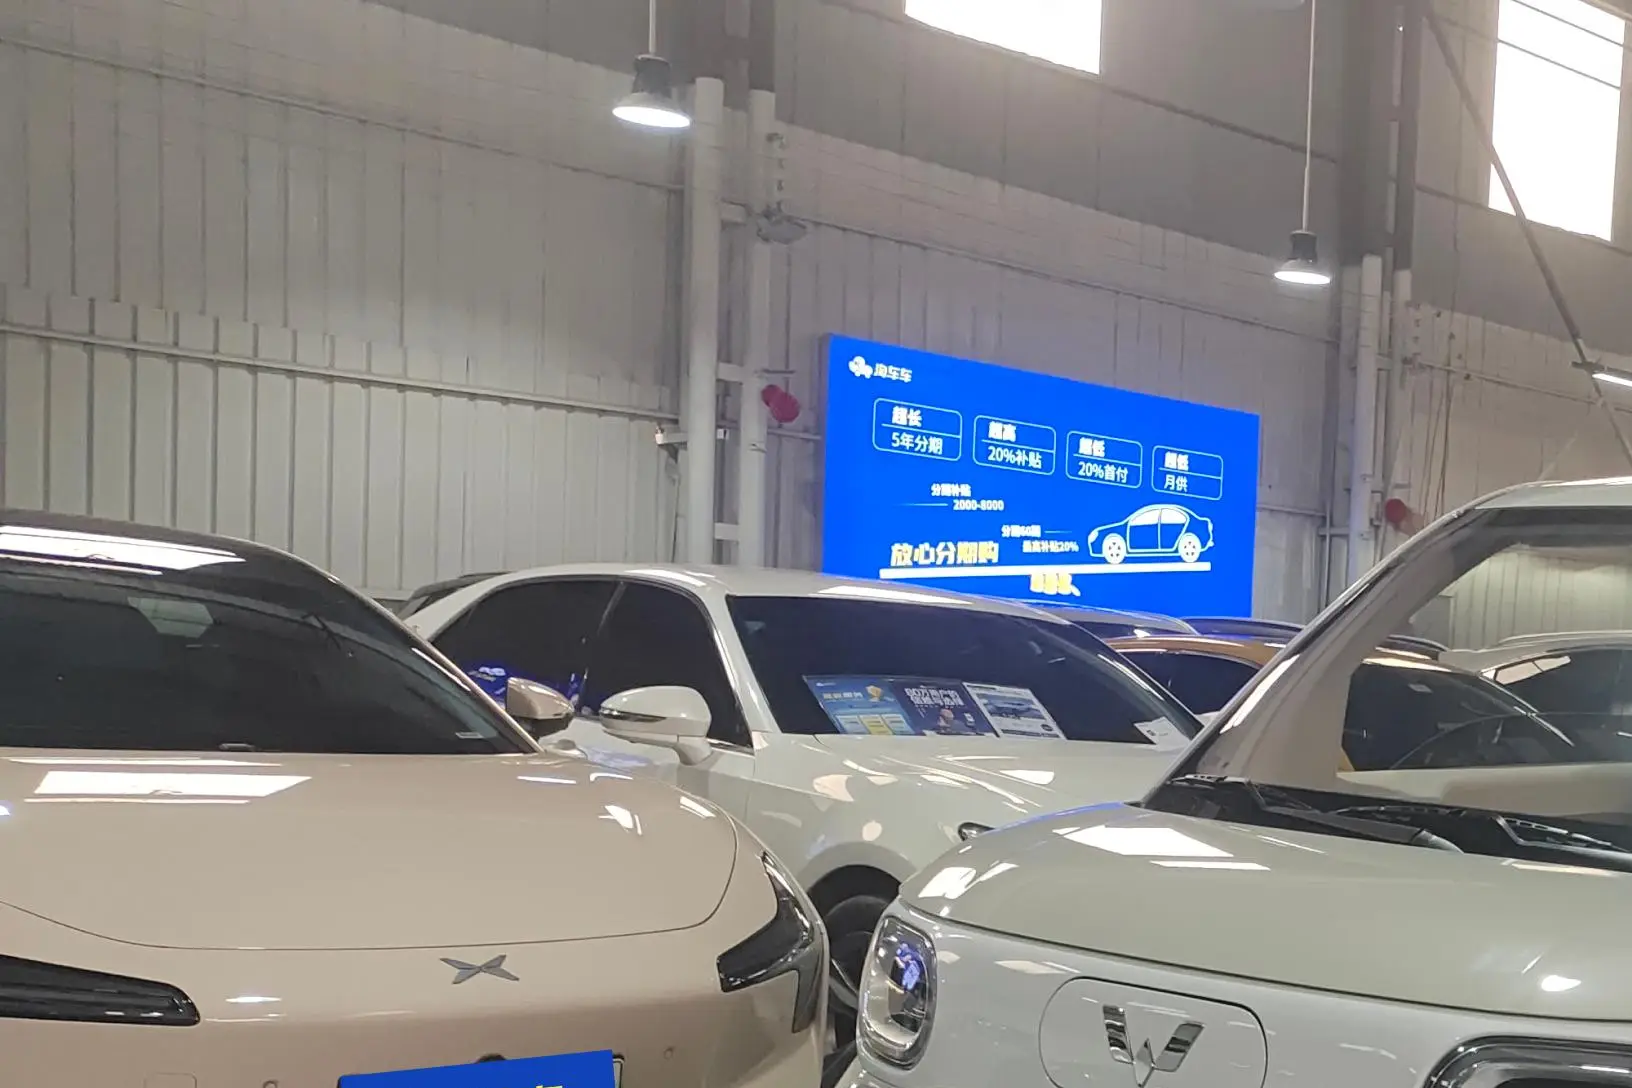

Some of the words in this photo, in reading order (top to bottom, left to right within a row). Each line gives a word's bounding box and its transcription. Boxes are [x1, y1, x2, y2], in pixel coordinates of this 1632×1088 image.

[891, 432, 943, 455] 5年分期
[987, 446, 1042, 469] 20%补贴
[1077, 461, 1128, 483] 20%首付
[1165, 473, 1189, 491] 月供
[954, 500, 1004, 510] 2000-8000
